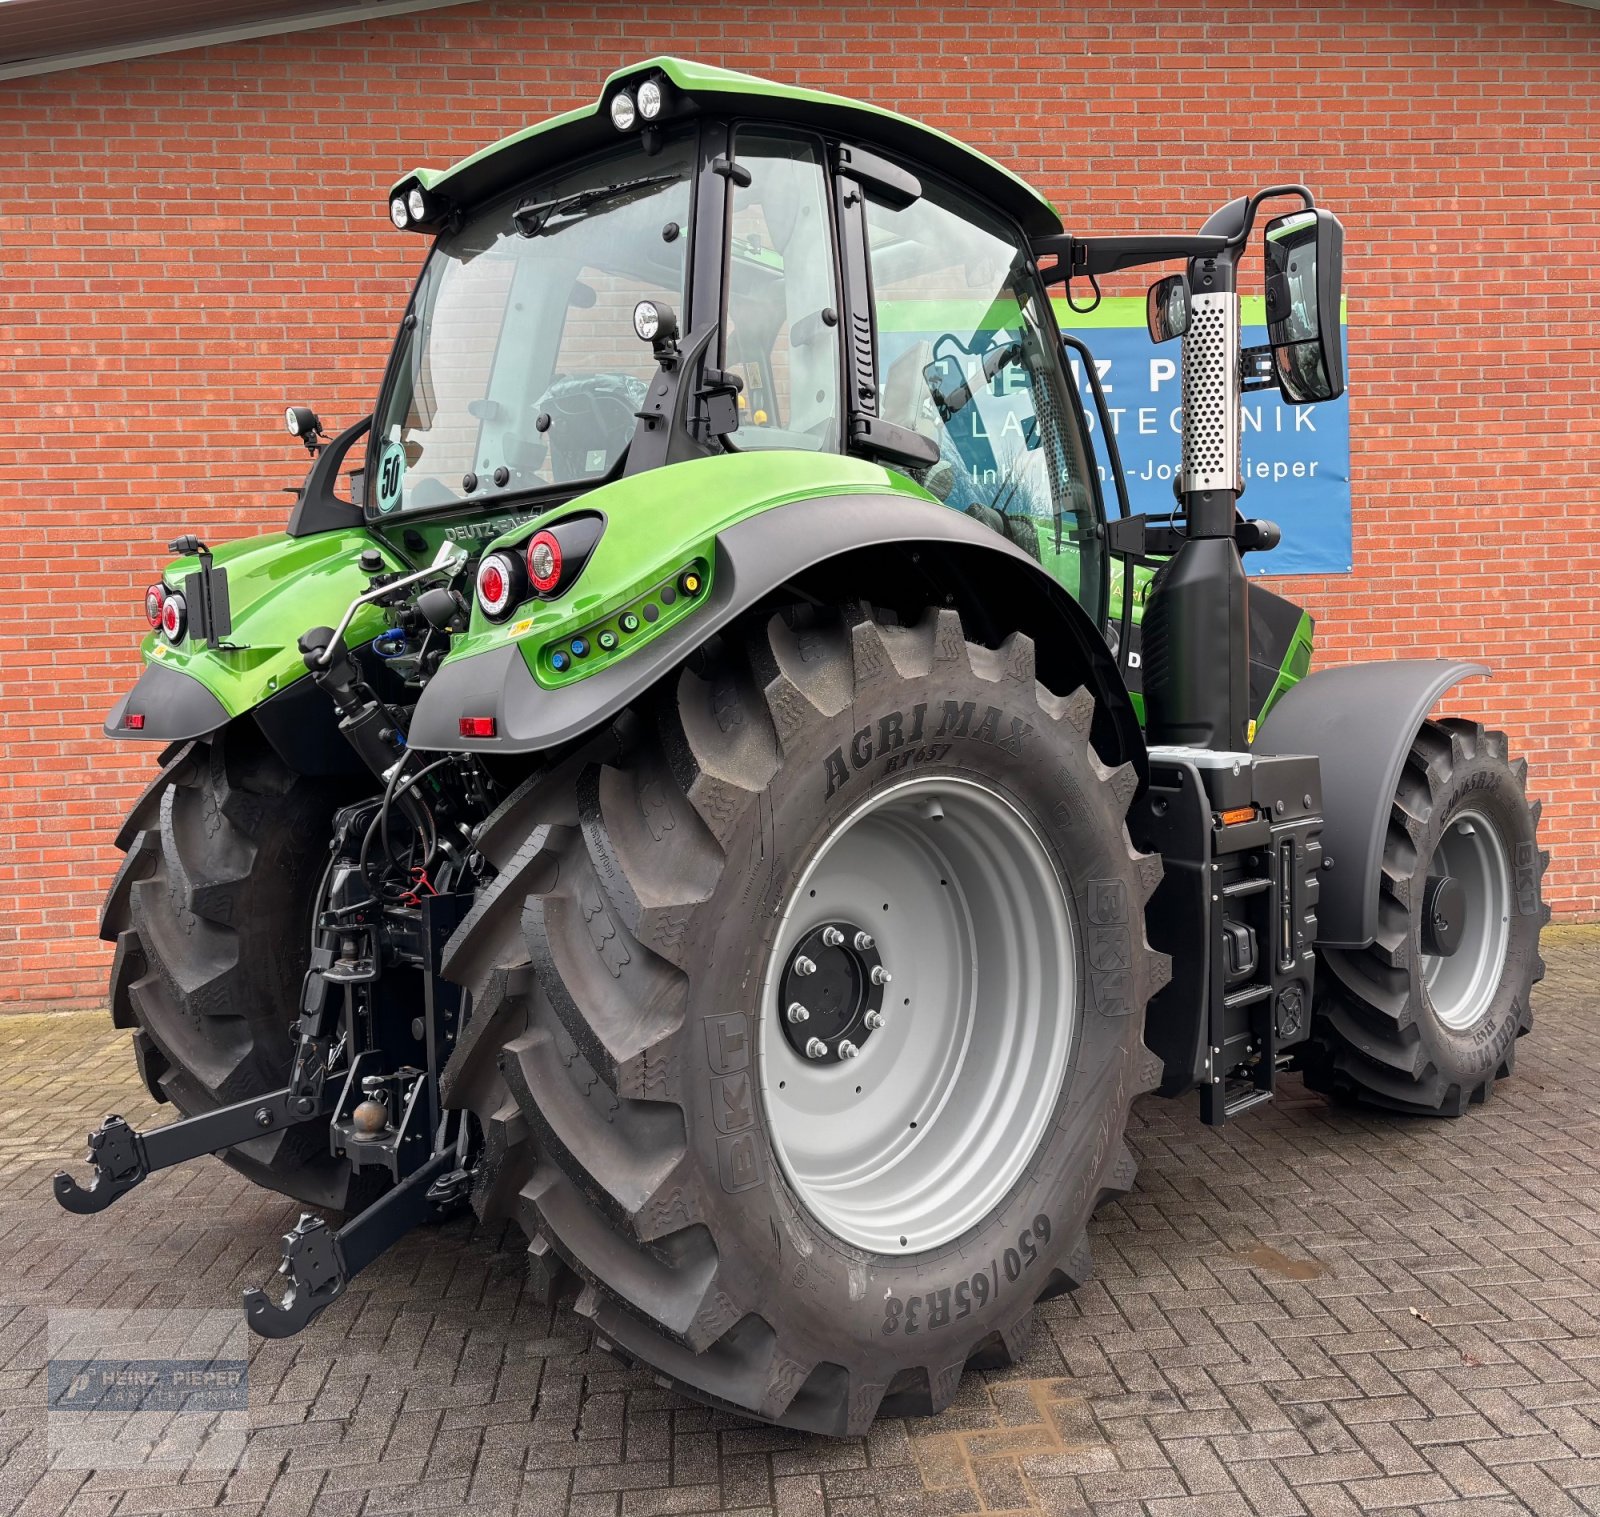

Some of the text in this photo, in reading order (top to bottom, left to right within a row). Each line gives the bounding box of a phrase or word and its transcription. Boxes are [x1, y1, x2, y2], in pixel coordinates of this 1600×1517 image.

[381, 454, 401, 500] 50
[1246, 456, 1319, 483] ieper
[1516, 841, 1537, 916] BKT
[1088, 878, 1136, 1018] BKT
[703, 1011, 765, 1195] BKT
